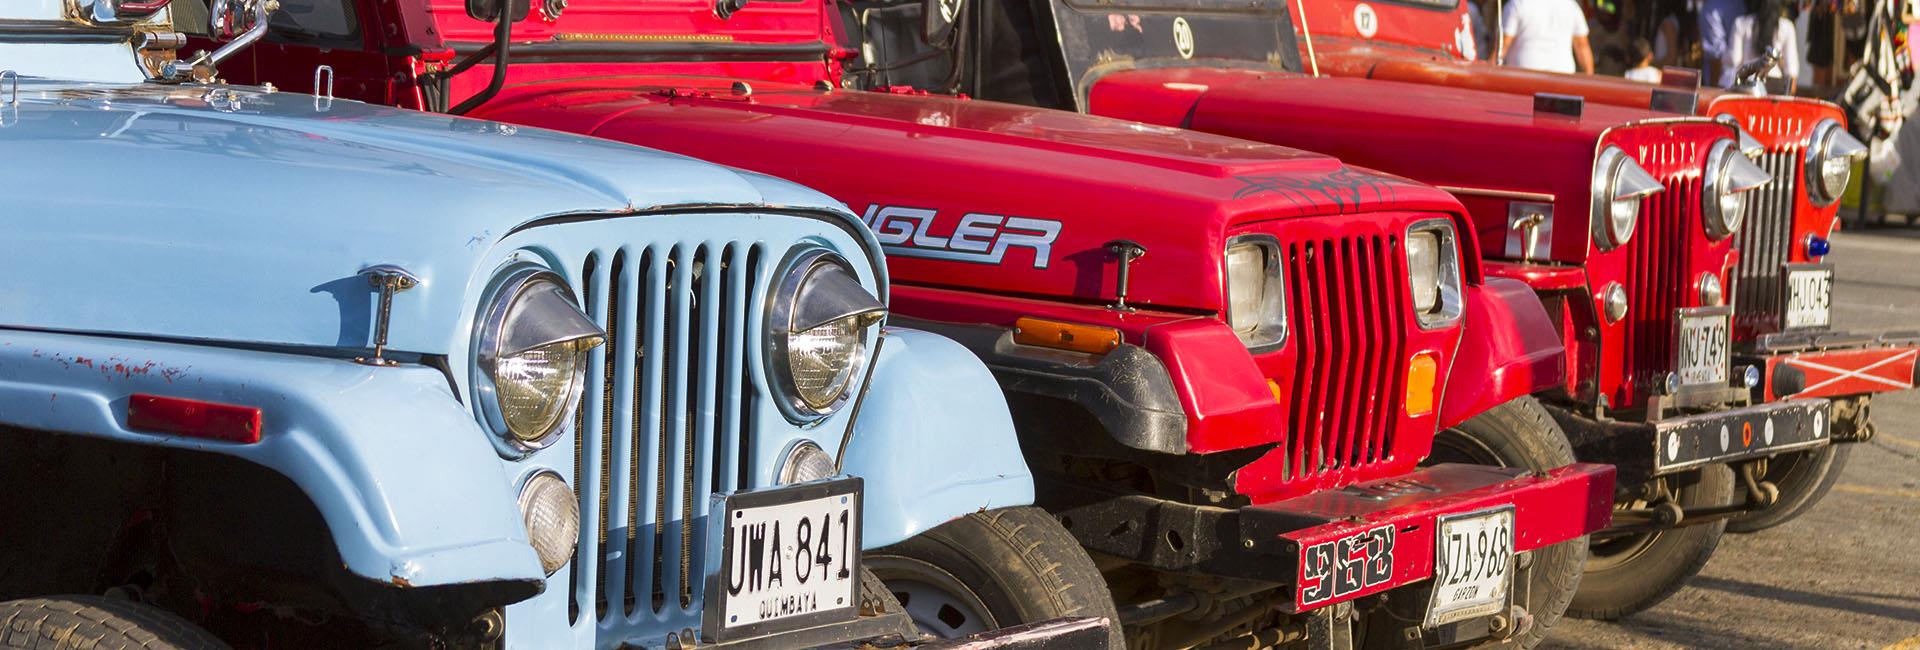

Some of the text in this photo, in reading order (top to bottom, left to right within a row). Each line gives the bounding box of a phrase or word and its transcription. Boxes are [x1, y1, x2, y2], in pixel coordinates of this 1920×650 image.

[1748, 115, 1802, 136] WILLYS
[1639, 141, 1696, 164] WILLYS
[1789, 278, 1806, 312] HJ
[1681, 326, 1724, 368] NJ 749
[728, 509, 850, 596] UWA 841
[1303, 524, 1395, 604] 968
[1474, 526, 1508, 581] 968
[759, 593, 817, 619] QUIMBAYA
